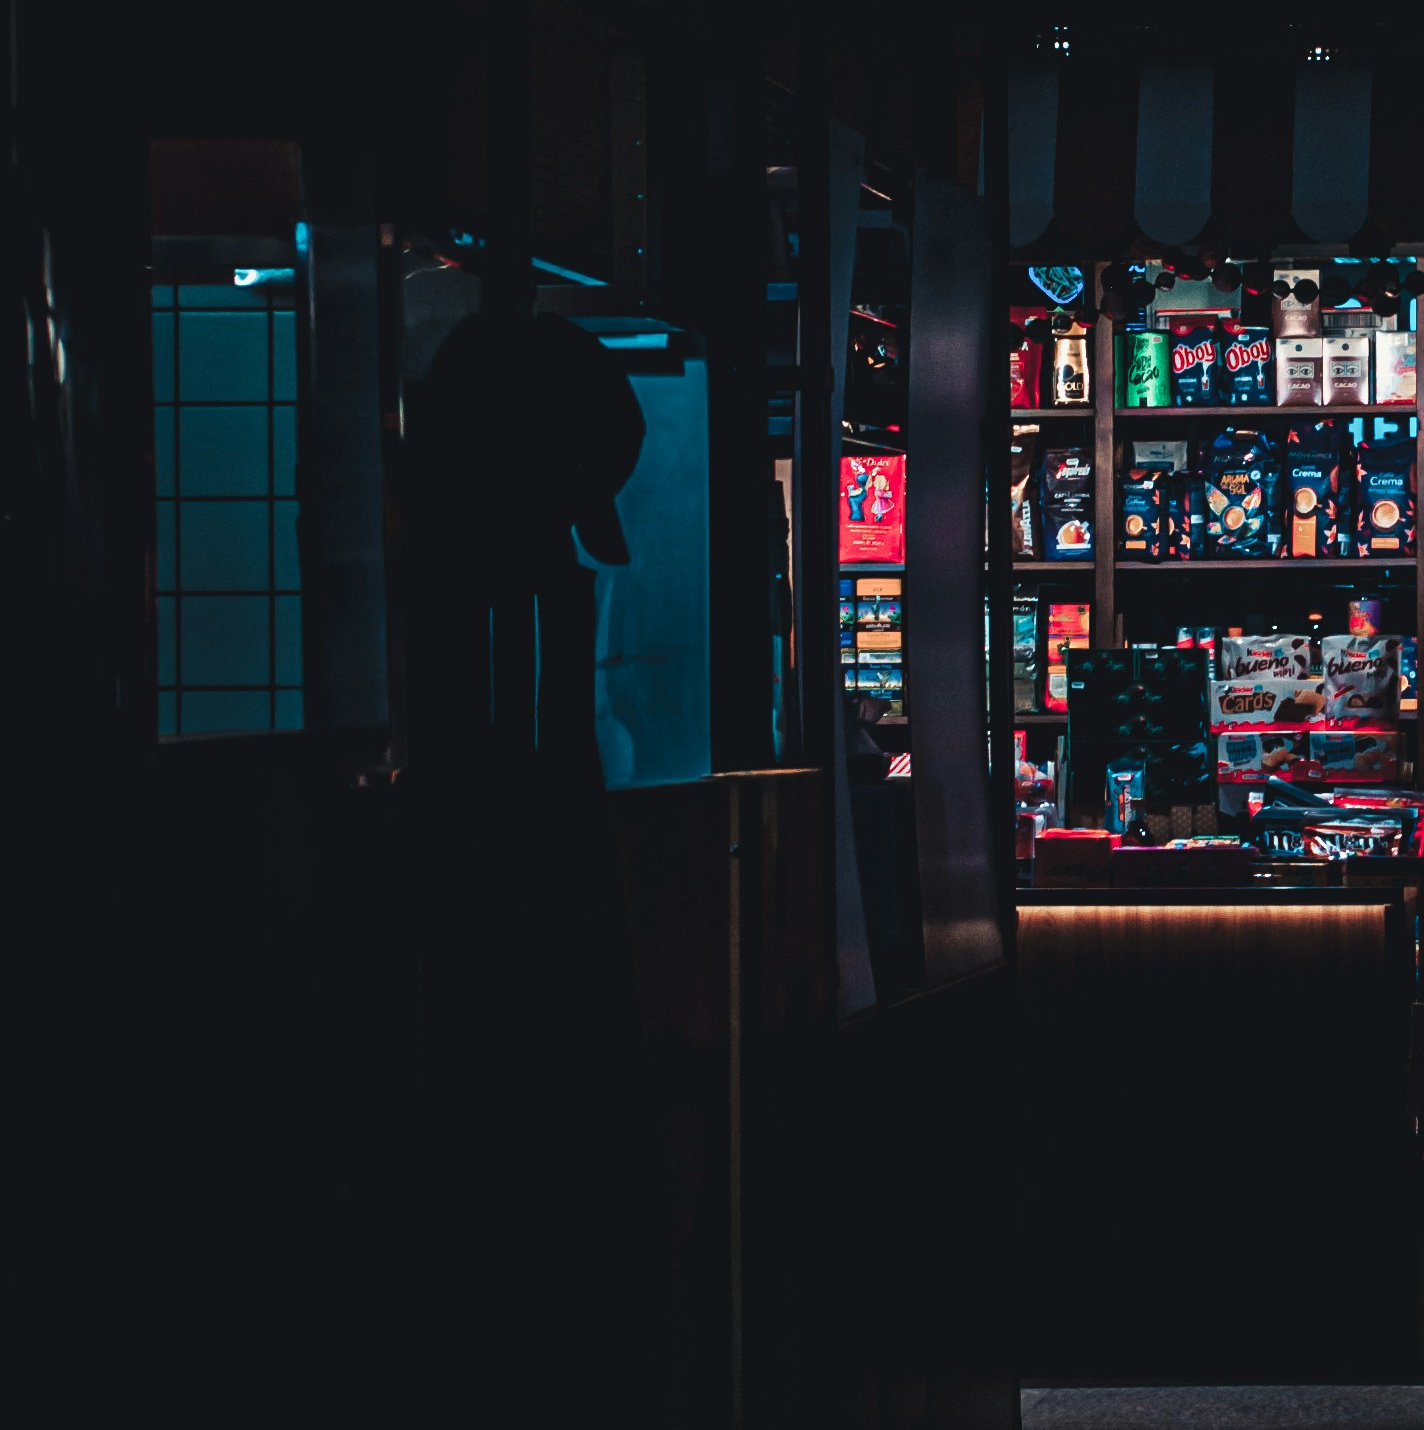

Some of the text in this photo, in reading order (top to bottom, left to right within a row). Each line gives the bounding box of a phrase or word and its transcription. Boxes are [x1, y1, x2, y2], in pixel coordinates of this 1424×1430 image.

[1171, 341, 1216, 373] O'boy
[1225, 340, 1271, 371] O'boy
[1292, 468, 1322, 479] Crema
[1369, 475, 1404, 487] Crema
[1234, 656, 1290, 677] bueno
[1327, 656, 1383, 678] bueno
[1221, 691, 1274, 714] Cards
